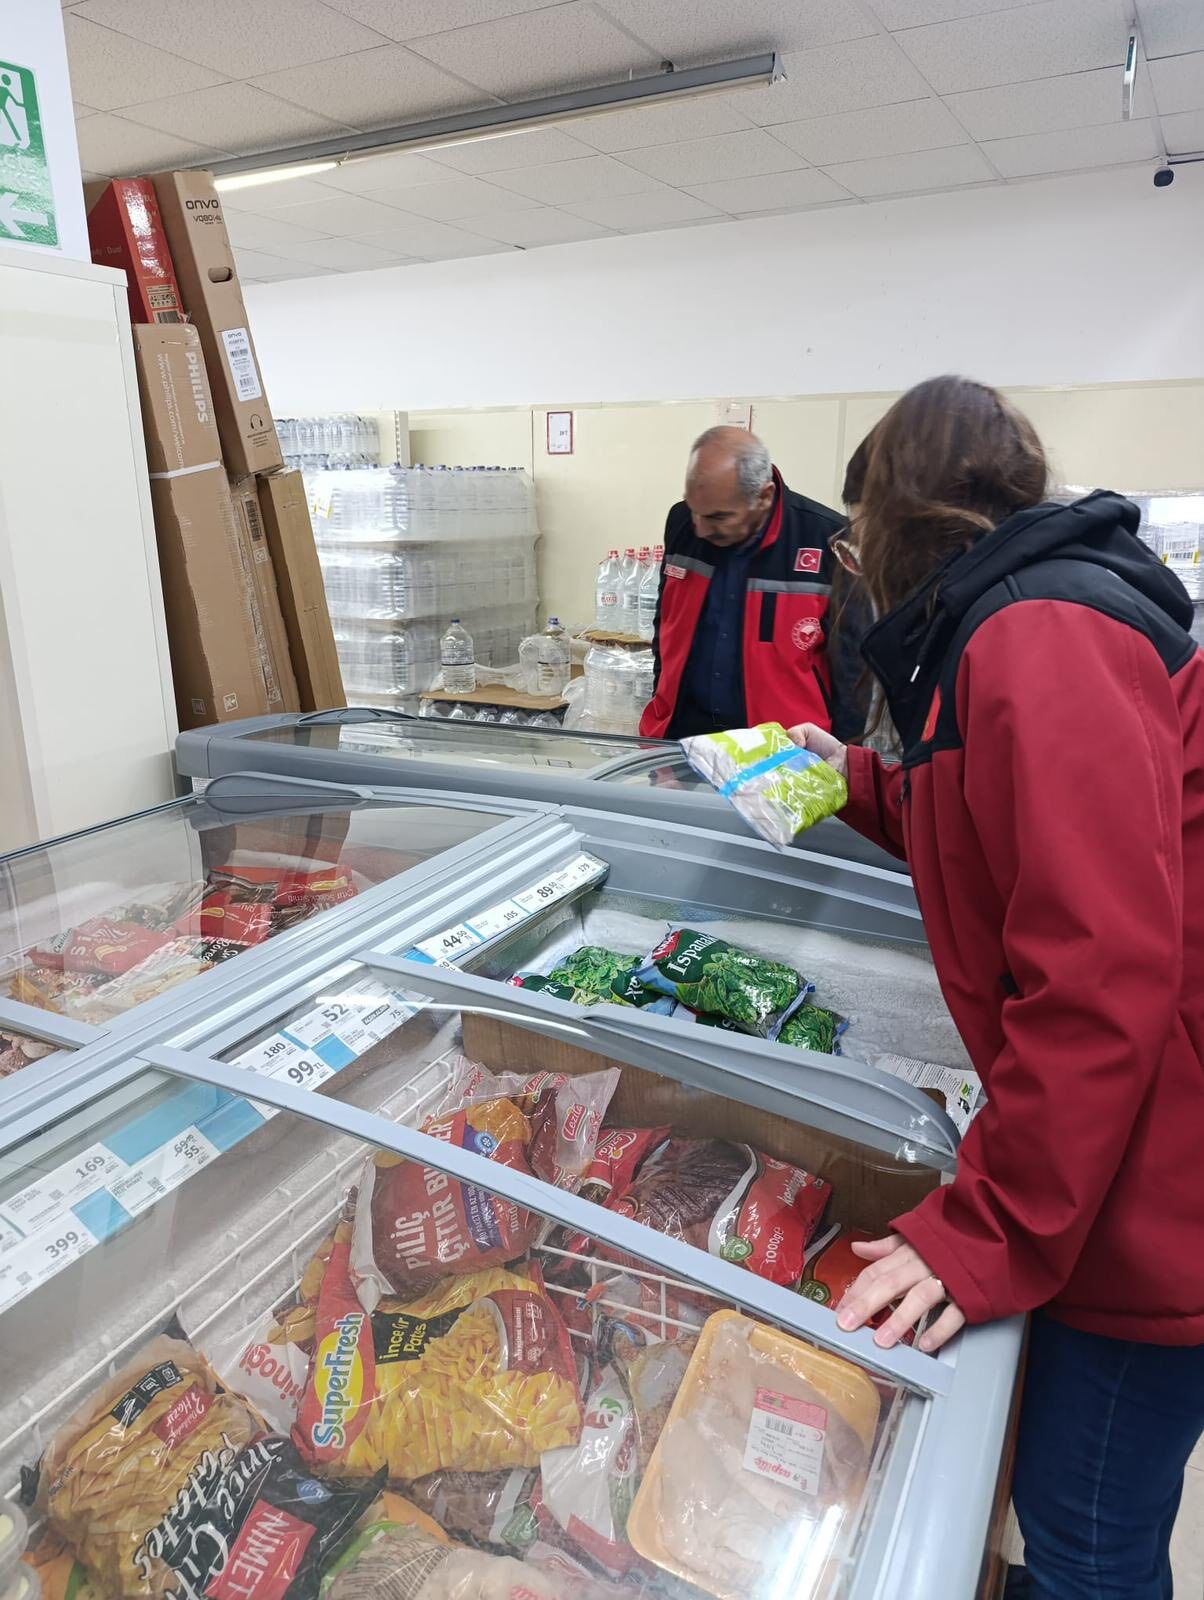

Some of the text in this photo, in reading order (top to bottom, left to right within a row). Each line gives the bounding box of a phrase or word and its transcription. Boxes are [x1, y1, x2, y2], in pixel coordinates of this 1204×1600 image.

[185, 351, 209, 423] PHILIPS
[577, 863, 591, 873] 179
[503, 910, 520, 922] 105
[321, 1003, 350, 1022] 52
[389, 1009, 402, 1020] 75
[263, 1042, 287, 1060] 180
[287, 1060, 315, 1084] 99
[183, 1144, 200, 1160] 55
[75, 1155, 106, 1180] 169
[390, 1211, 431, 1270] PİLİÇ
[432, 1192, 470, 1263] ÇITIR
[44, 1231, 80, 1259] 399
[312, 1311, 365, 1449] SuperFresh
[166, 1395, 193, 1427] Hazır
[132, 1431, 242, 1582] Patates
[227, 1511, 291, 1600] NİMET
